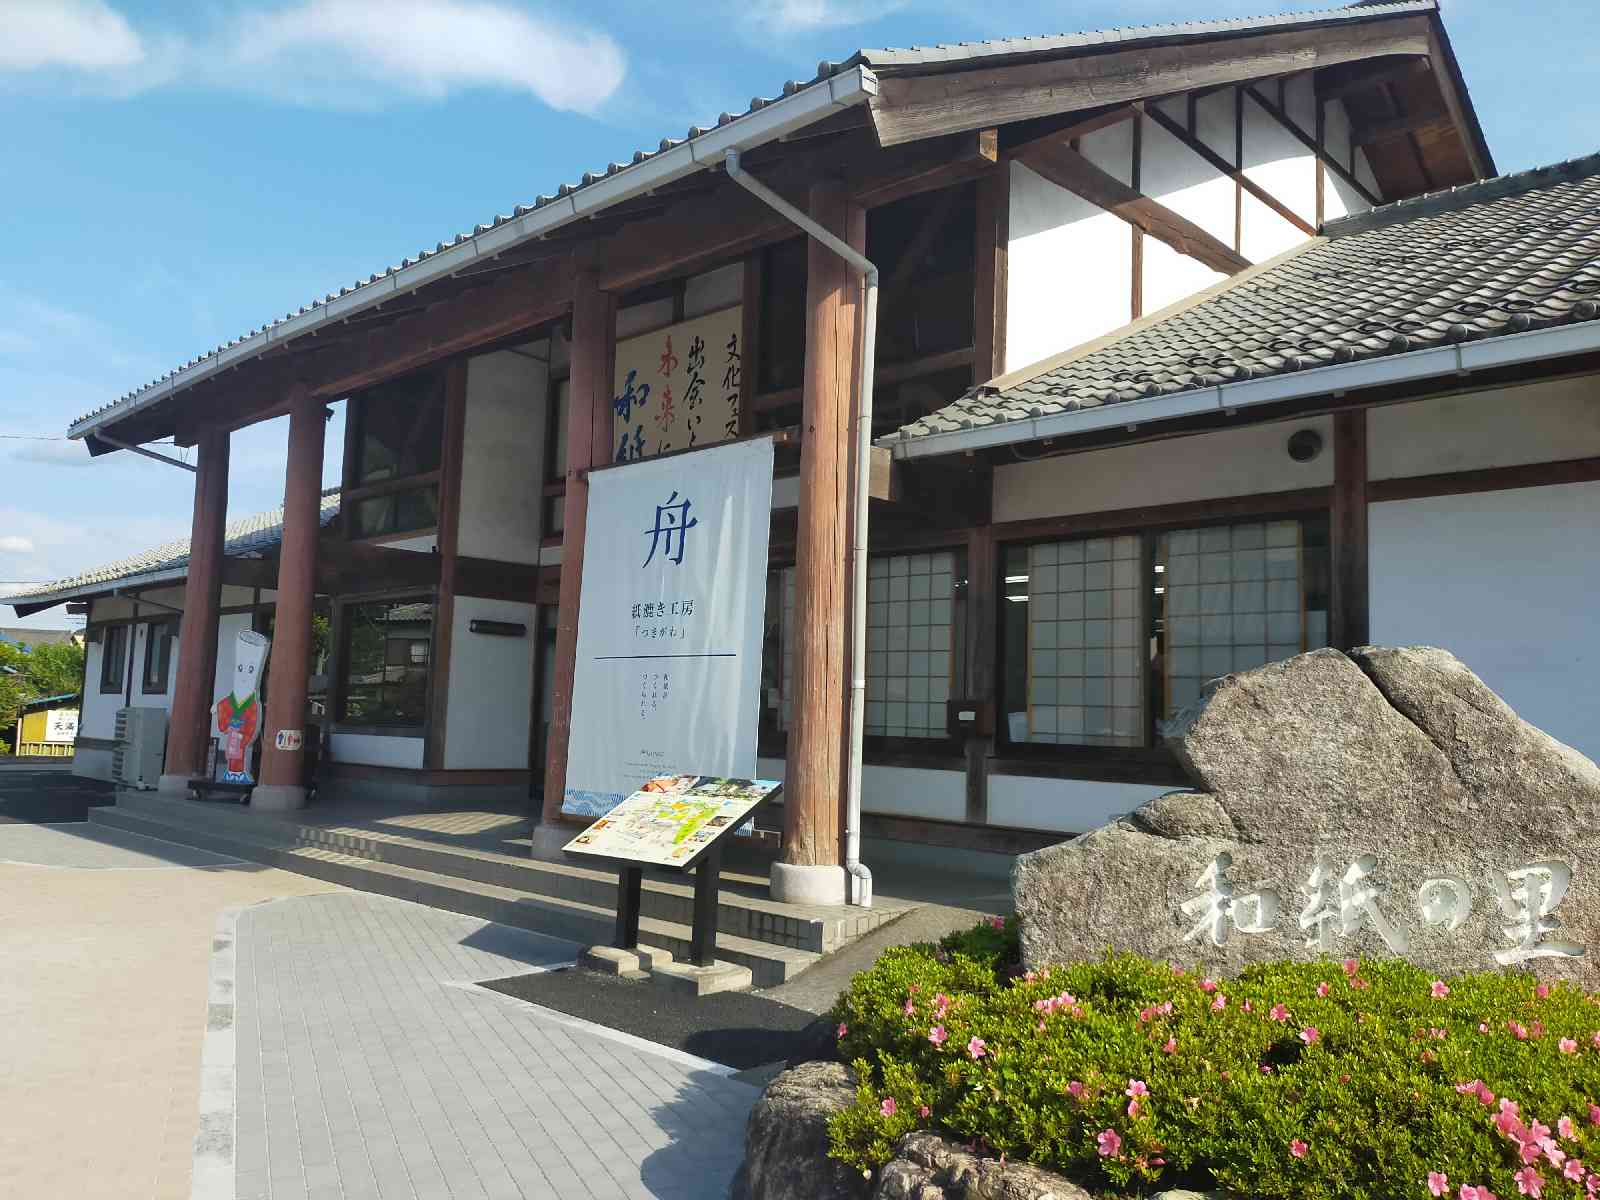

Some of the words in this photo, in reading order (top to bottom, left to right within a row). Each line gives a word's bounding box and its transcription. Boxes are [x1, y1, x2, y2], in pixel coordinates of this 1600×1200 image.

[642, 489, 698, 569] 舟
[632, 599, 695, 619] 紙漉き工房
[1179, 850, 1586, 965] 和紙の里
